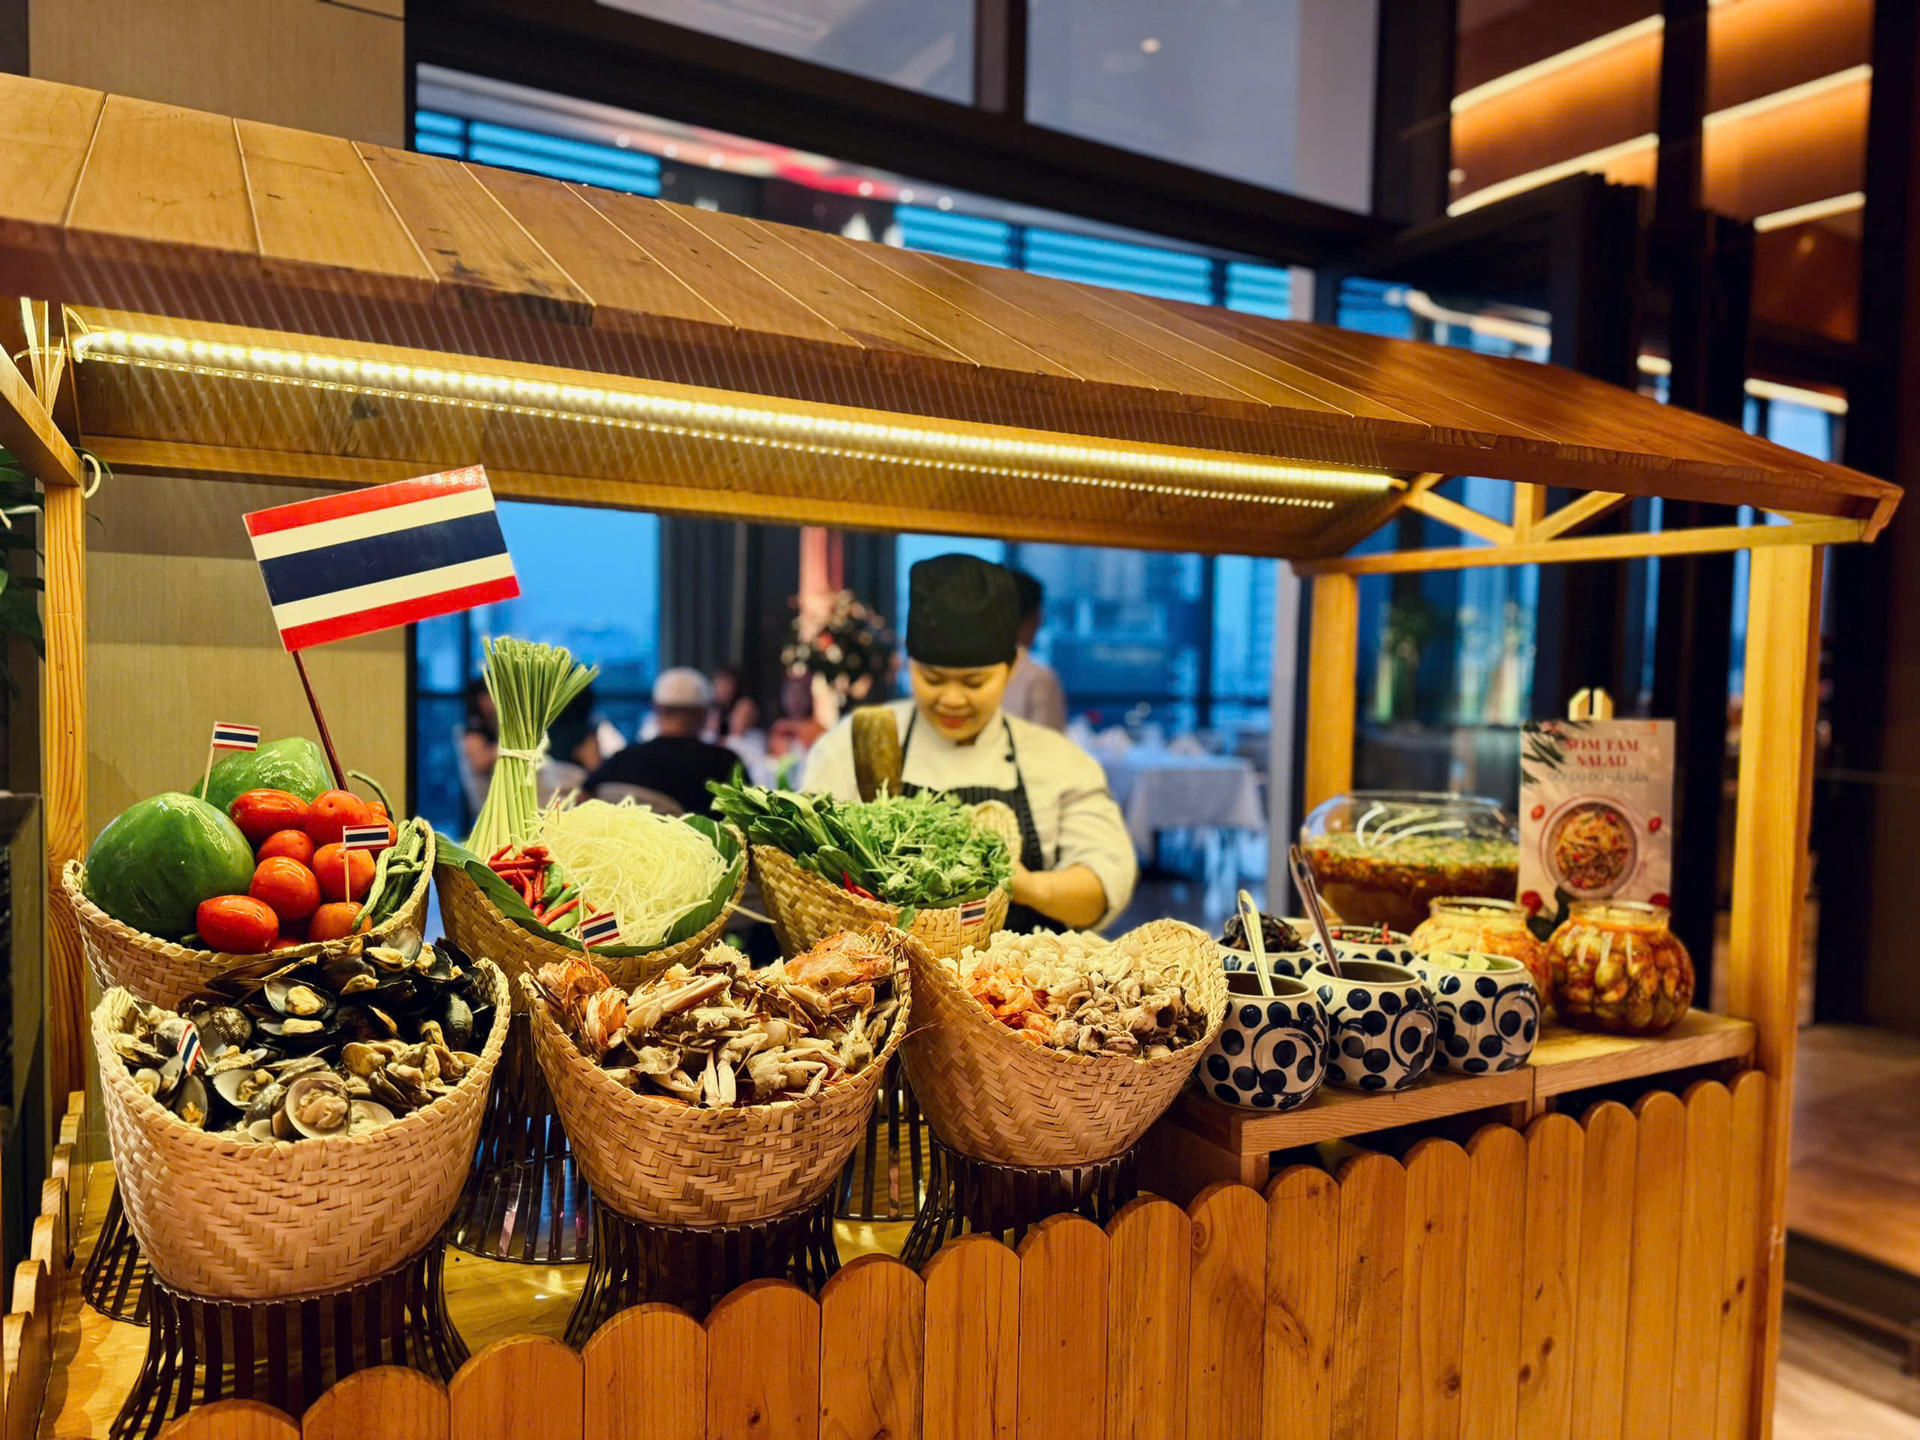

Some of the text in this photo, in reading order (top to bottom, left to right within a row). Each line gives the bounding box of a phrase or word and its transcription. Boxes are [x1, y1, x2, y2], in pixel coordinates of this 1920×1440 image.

[1565, 739, 1639, 751] SOM TAM
[1576, 754, 1628, 767] SALAD
